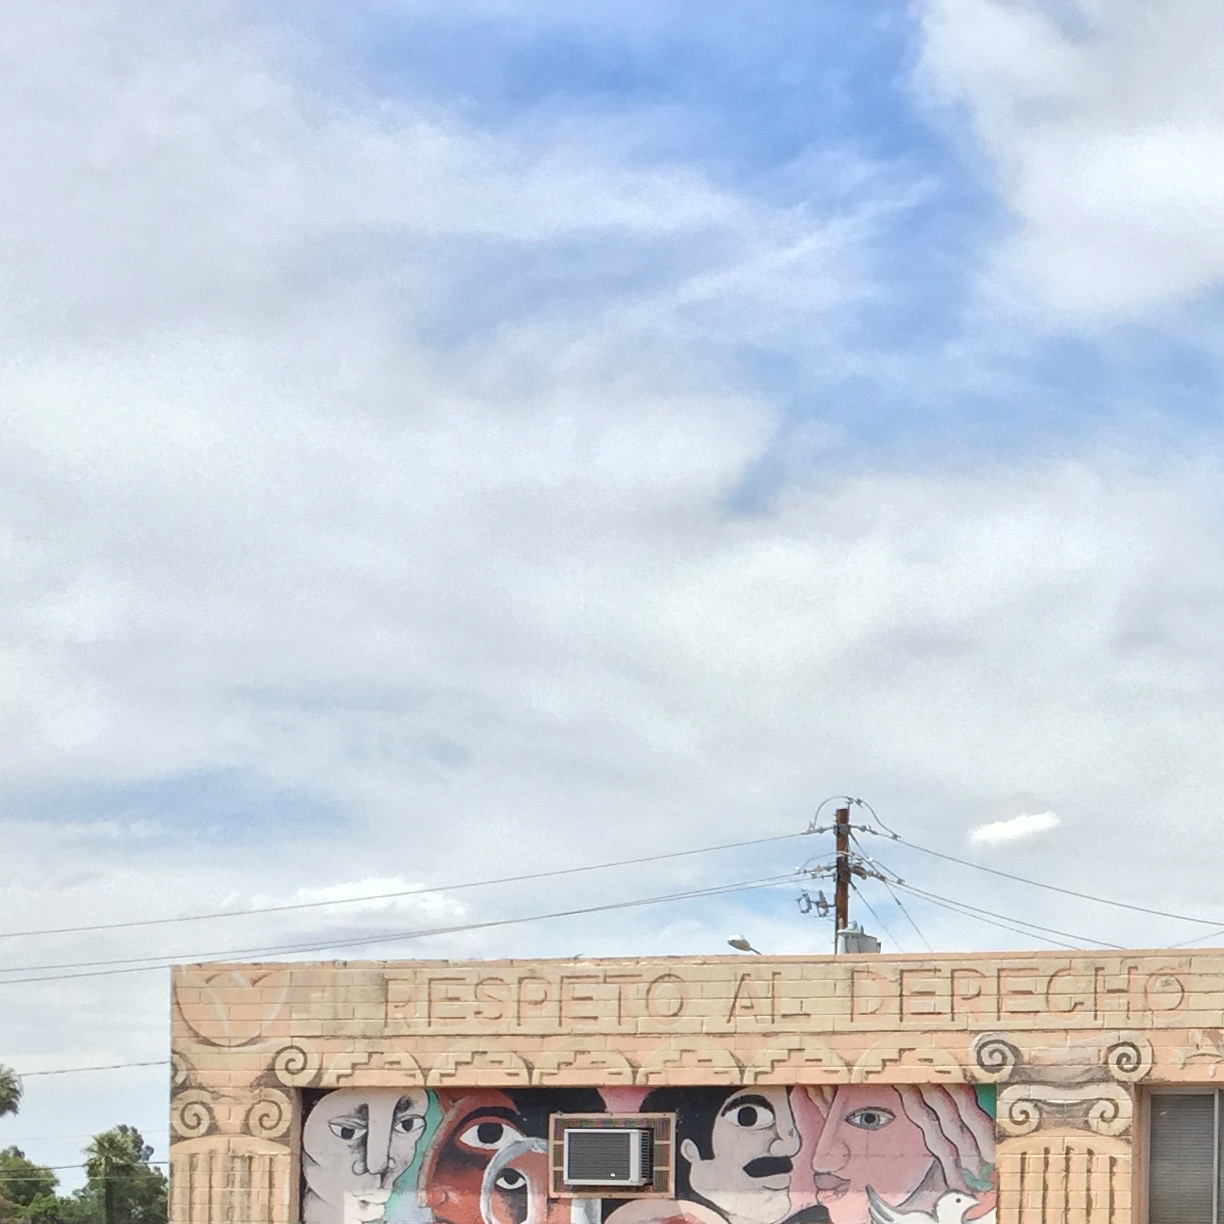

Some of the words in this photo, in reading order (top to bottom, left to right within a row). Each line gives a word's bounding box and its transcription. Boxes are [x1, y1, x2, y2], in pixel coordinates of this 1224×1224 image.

[384, 973, 687, 1028] RESPETO
[727, 972, 811, 1025] AL
[850, 965, 1188, 1024] DERECHO
